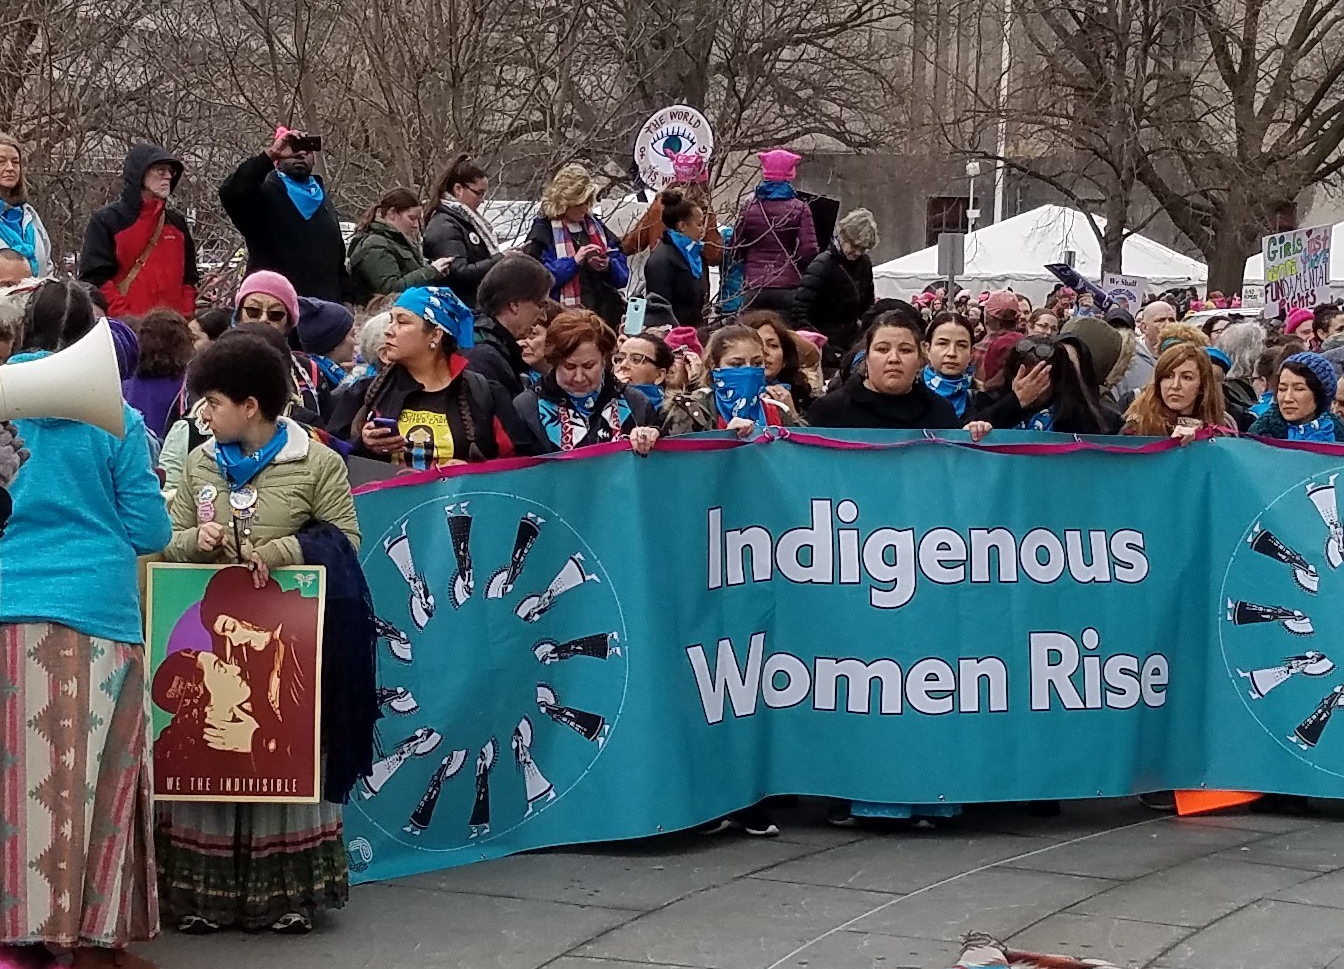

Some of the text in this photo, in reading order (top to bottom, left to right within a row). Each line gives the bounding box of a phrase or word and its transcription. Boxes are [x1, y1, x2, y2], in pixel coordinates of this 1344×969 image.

[644, 110, 702, 135] THE WORLD
[1264, 264, 1331, 305] FUNDAMENTAL
[707, 498, 1149, 609] Indigenous
[685, 627, 1170, 726] Women Rise
[166, 776, 297, 793] WE THE INDIVISIBLE
